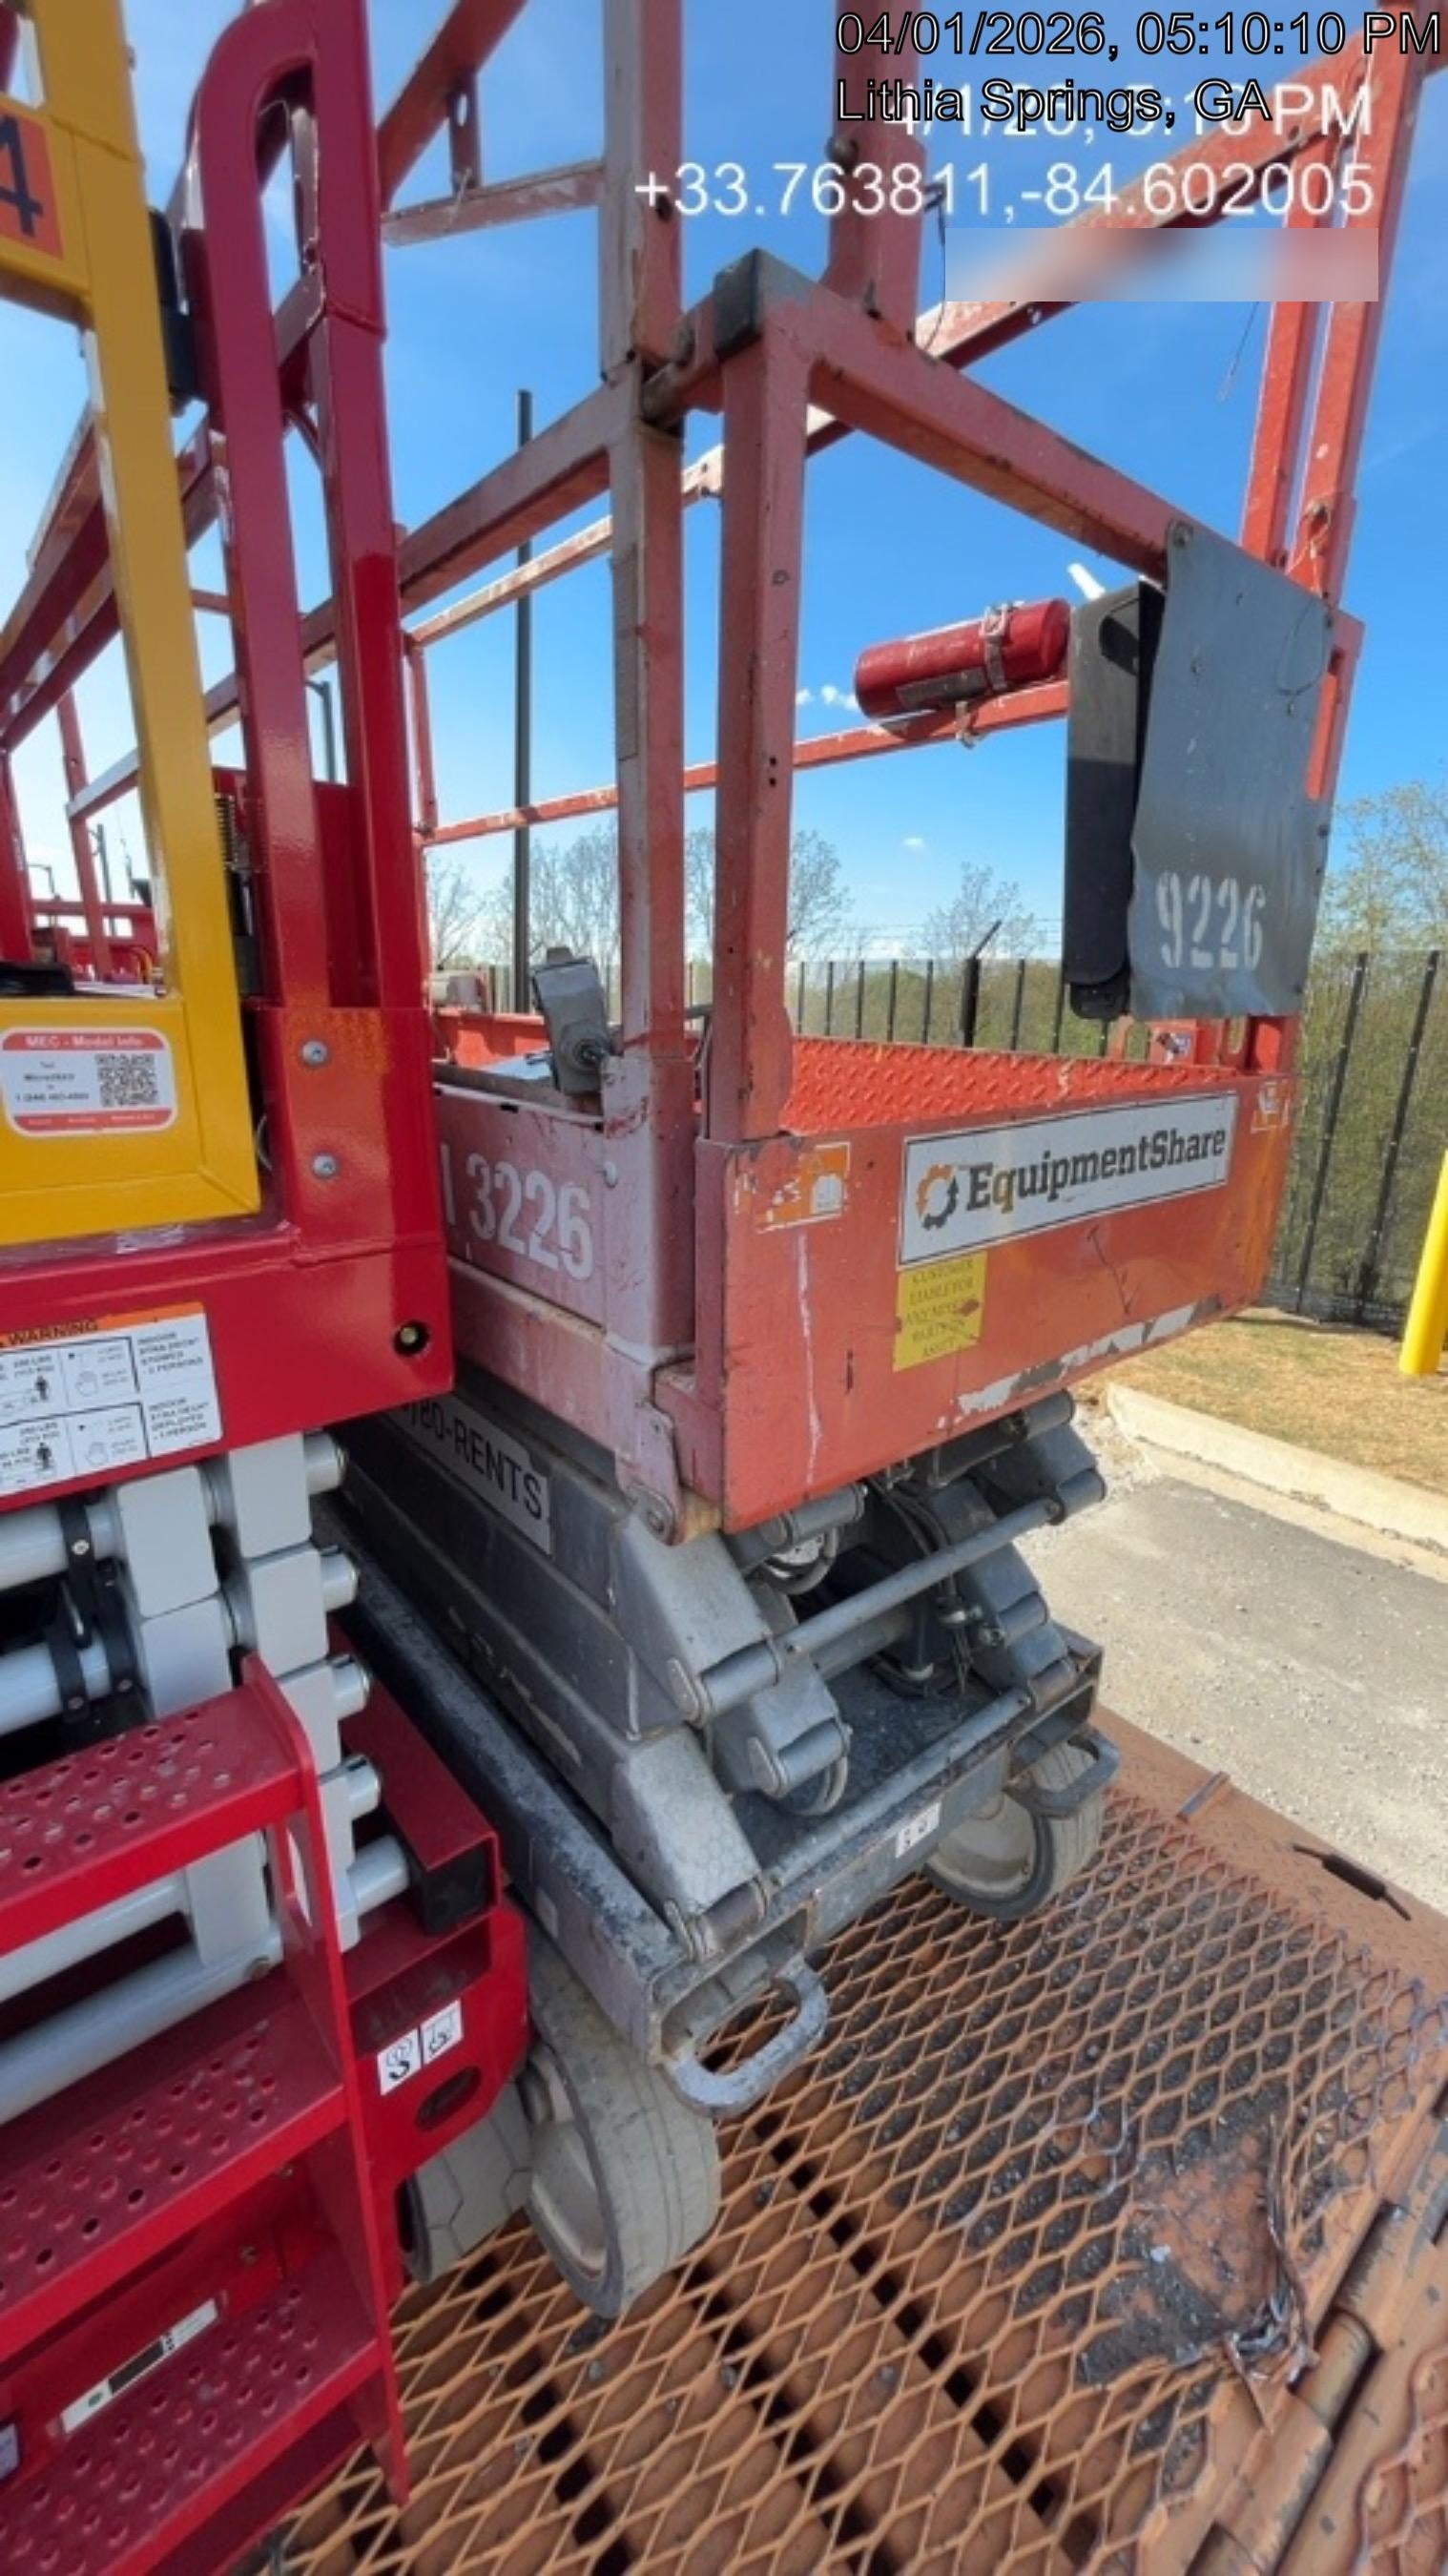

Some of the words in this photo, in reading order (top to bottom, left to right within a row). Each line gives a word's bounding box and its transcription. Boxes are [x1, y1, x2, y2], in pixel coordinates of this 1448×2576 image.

[1156, 872, 1266, 970] 9226
[26, 1035, 60, 1049] MEC
[966, 1128, 1227, 1213] EquipmentShare
[465, 1152, 595, 1281] 3226
